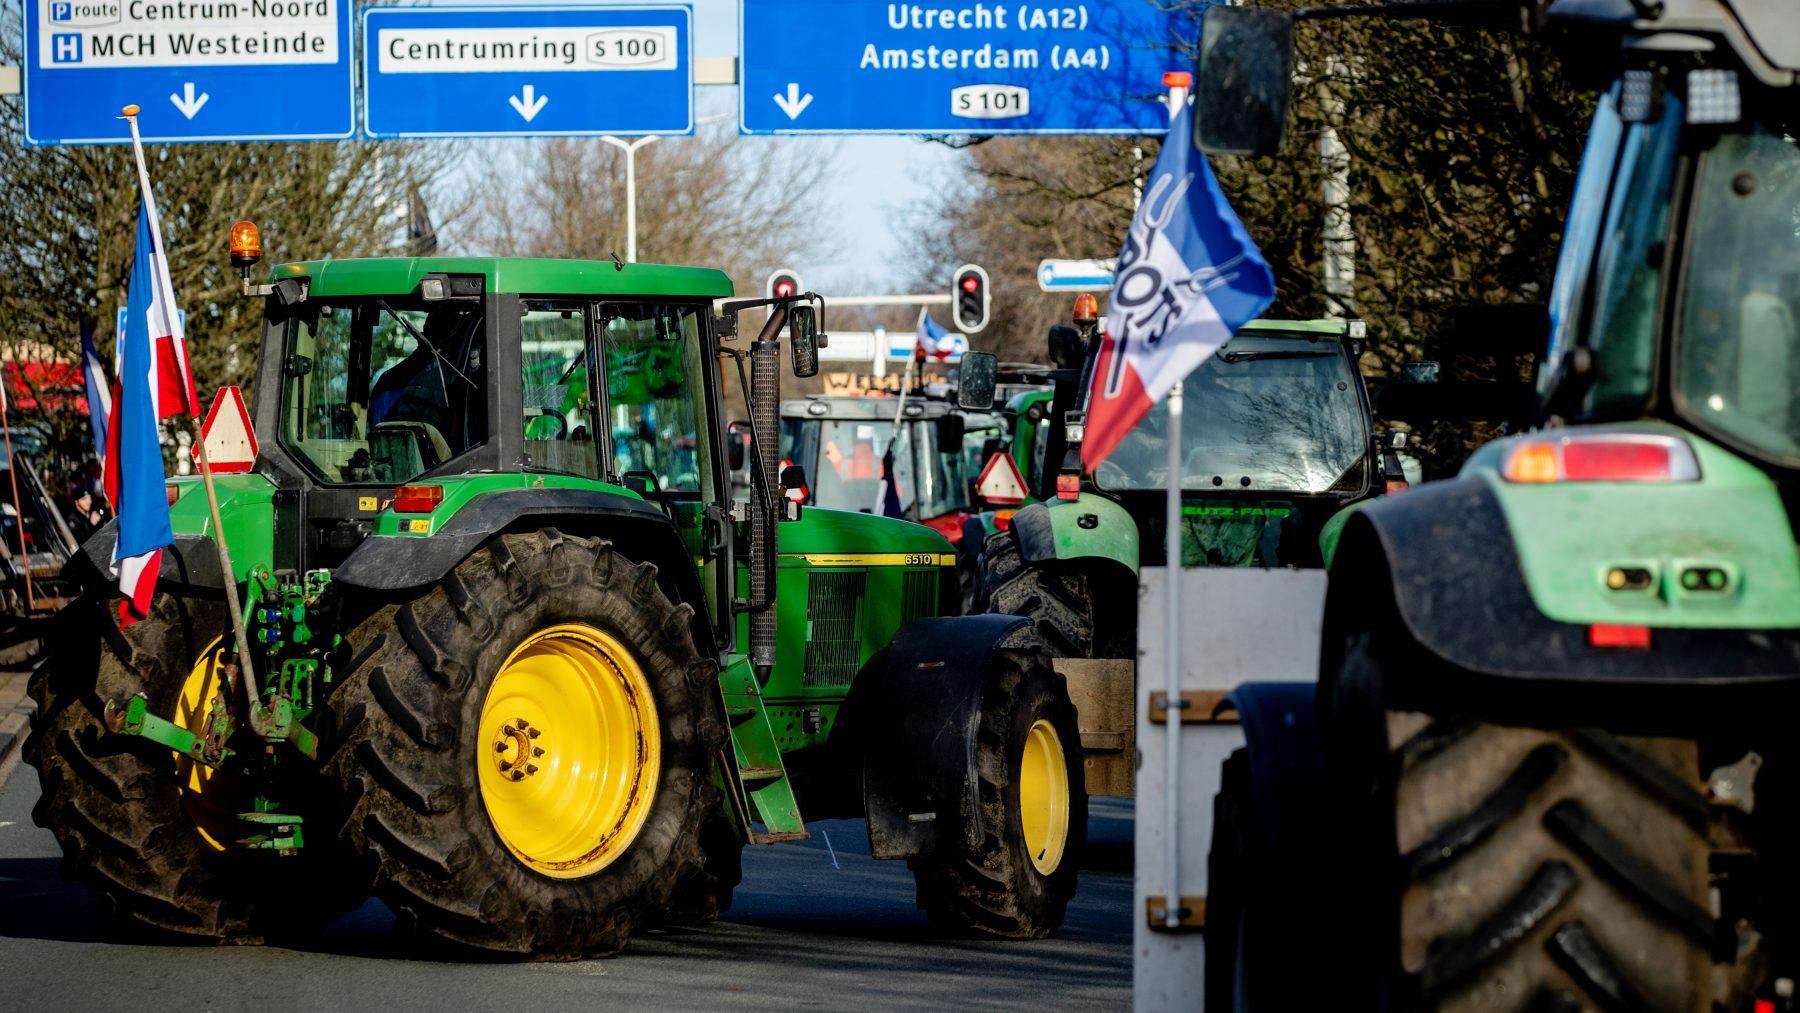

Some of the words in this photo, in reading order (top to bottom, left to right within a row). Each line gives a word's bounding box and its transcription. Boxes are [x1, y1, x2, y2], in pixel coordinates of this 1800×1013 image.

[75, 3, 118, 17] route
[129, 0, 328, 20] Centrum-Noord
[888, 4, 1008, 29] Utrecht
[1018, 5, 1088, 31] (A12)
[92, 34, 155, 56] MCH
[168, 31, 325, 55] Westeinde
[389, 36, 576, 64] Centrumring
[595, 41, 606, 57] S
[614, 39, 657, 56] 100
[860, 43, 1039, 69] Amsterdam
[1050, 45, 1110, 70] (A4)
[960, 93, 971, 110] S
[979, 92, 1021, 110] 101
[905, 555, 932, 565] 6510
